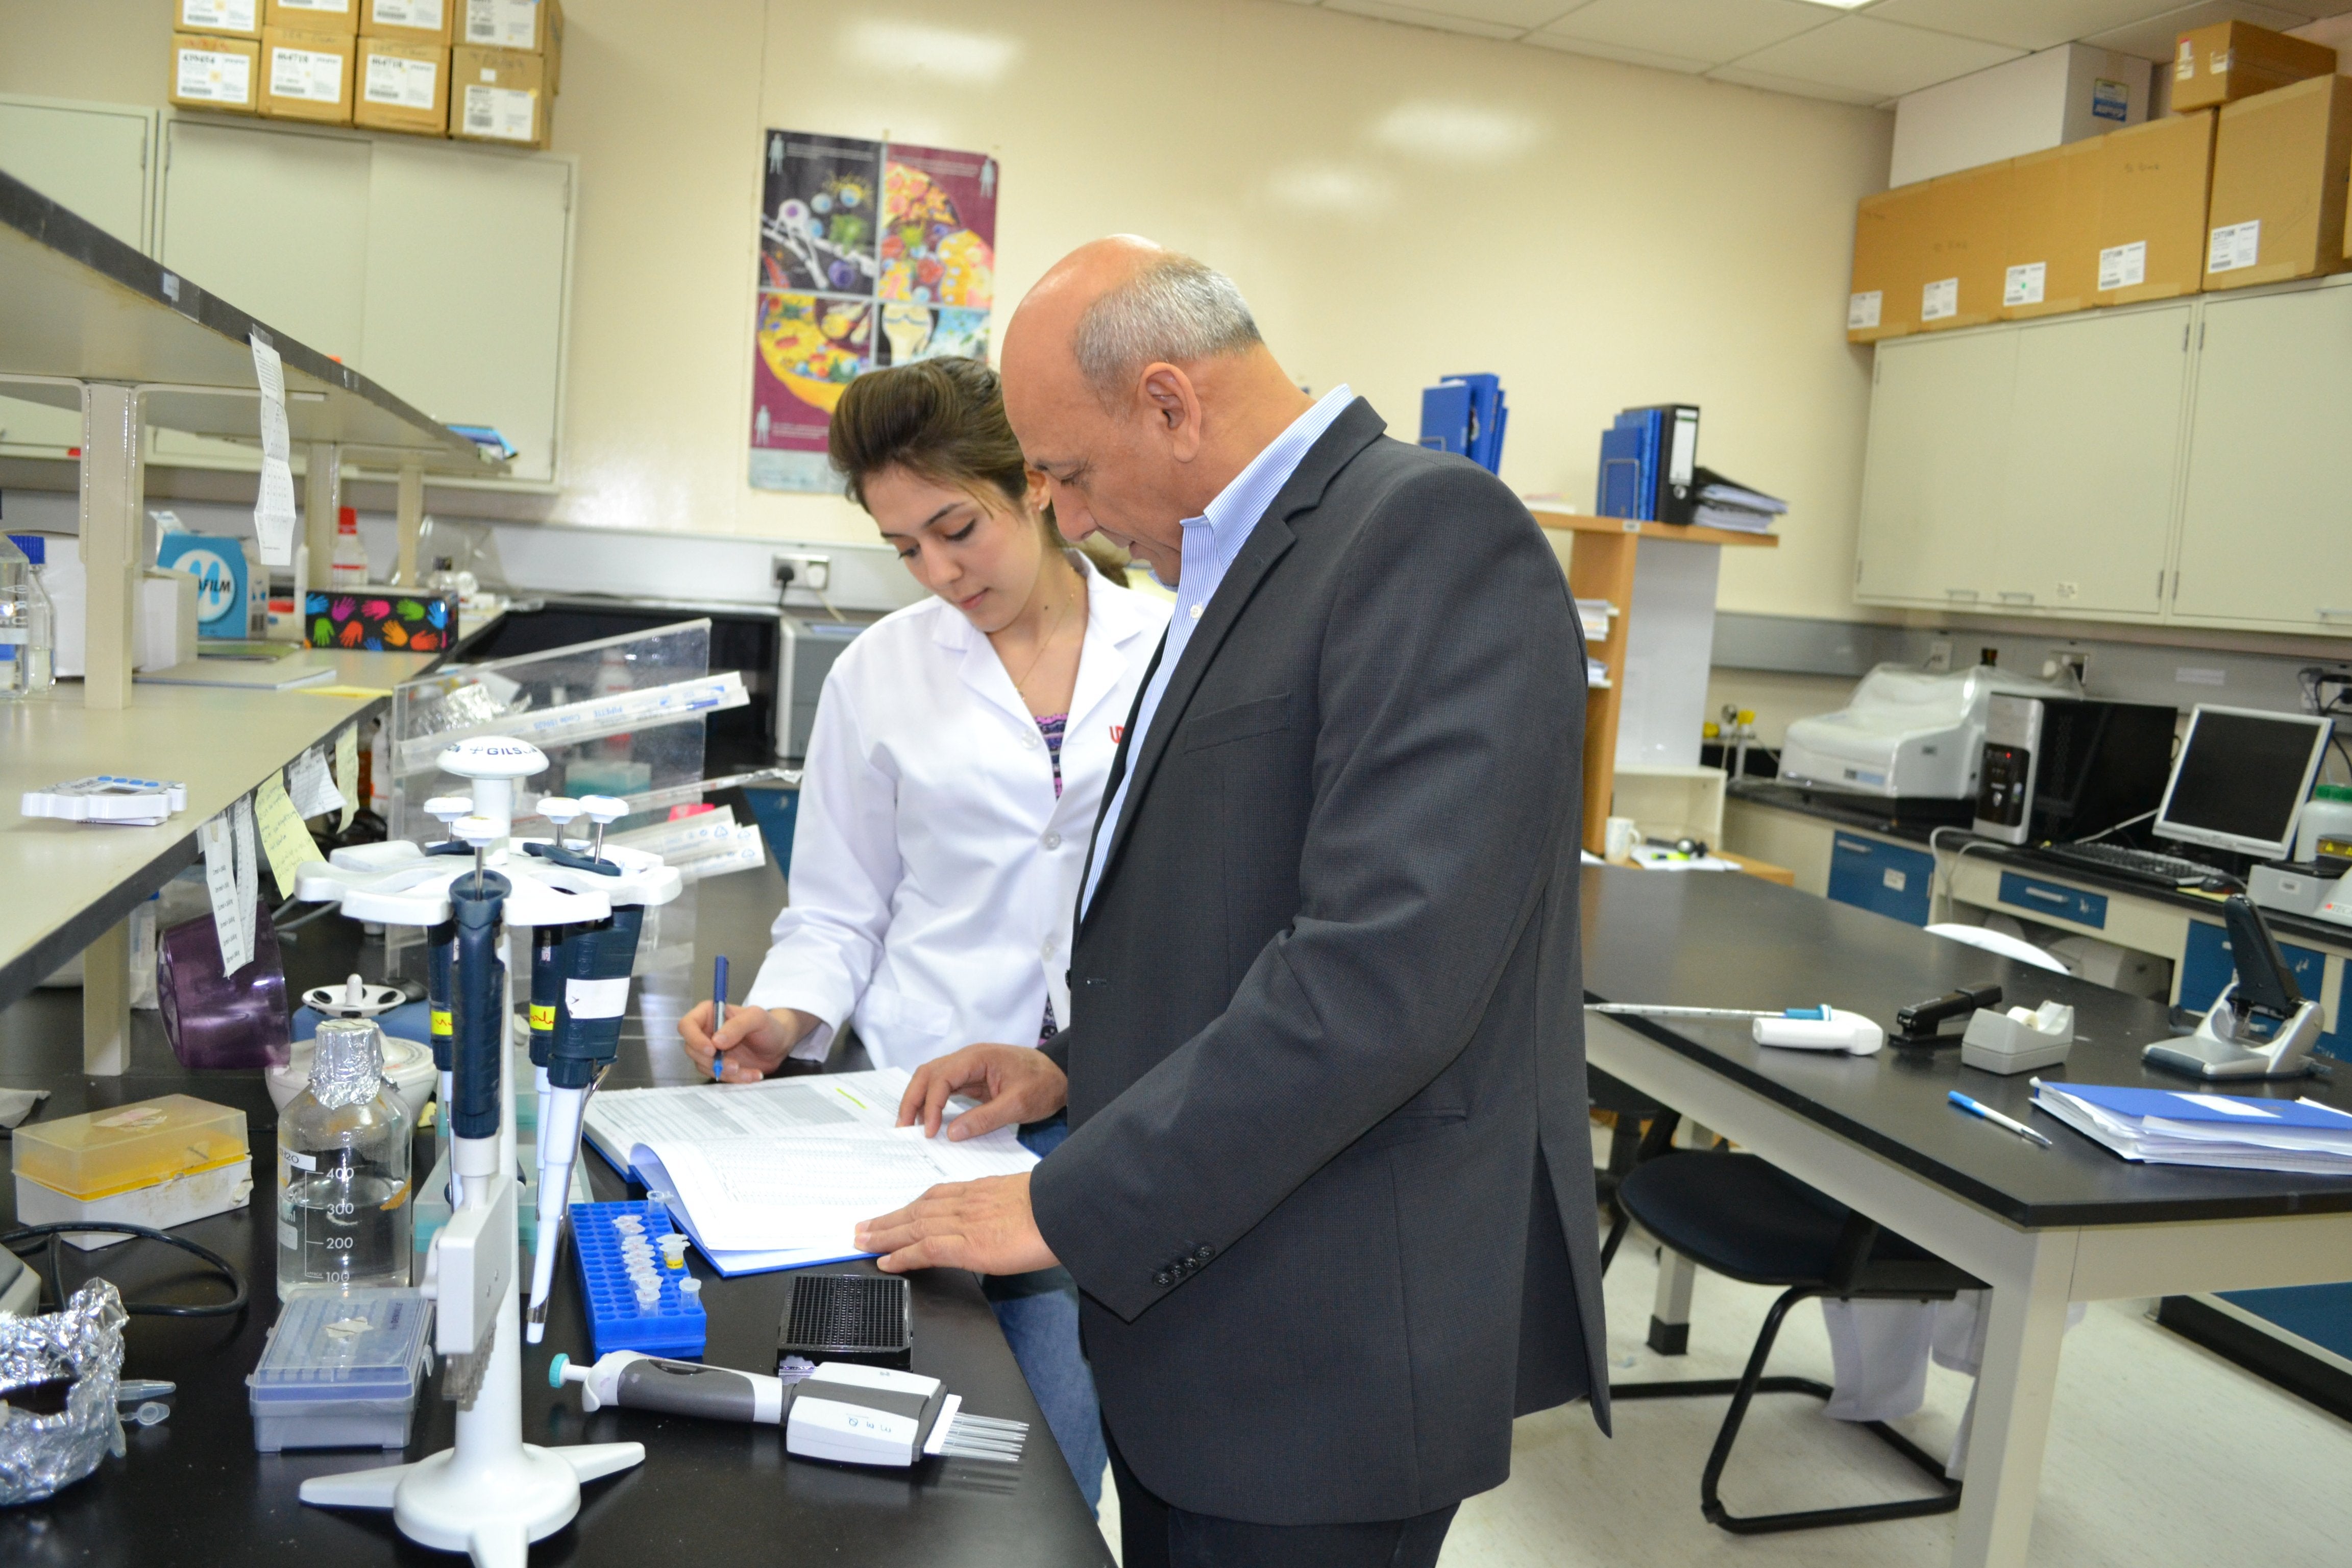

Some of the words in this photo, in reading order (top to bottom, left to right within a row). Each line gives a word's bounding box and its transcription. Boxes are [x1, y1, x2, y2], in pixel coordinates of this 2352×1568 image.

[326, 1168, 354, 1179] 400
[327, 1203, 354, 1215] 300
[326, 1237, 353, 1249] 200
[326, 1271, 350, 1283] 100
